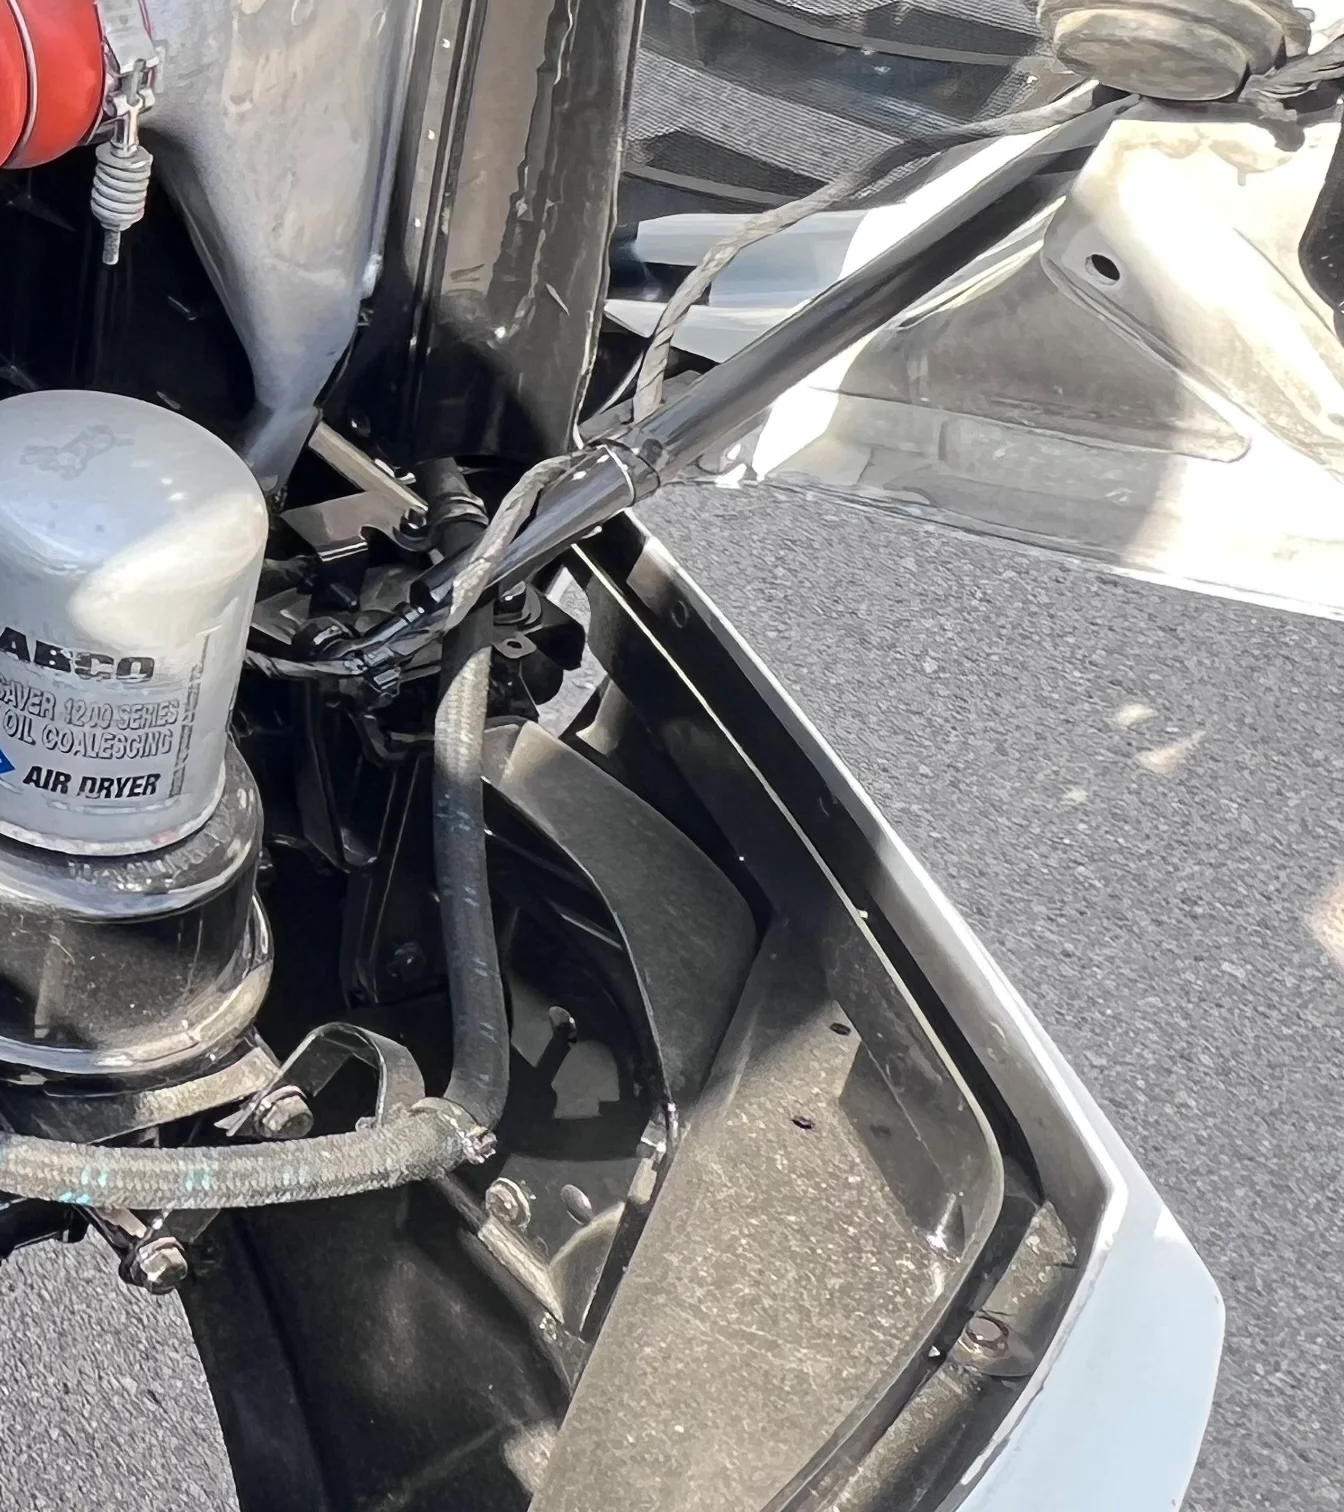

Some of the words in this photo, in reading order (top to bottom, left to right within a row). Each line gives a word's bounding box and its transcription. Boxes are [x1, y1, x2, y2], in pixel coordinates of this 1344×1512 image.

[63, 696, 114, 730] 1200
[115, 698, 180, 731] SERIES
[3, 708, 37, 746] OIL
[41, 723, 174, 760] COALESCING
[22, 765, 72, 795] AIR
[76, 773, 161, 800] DRYER
